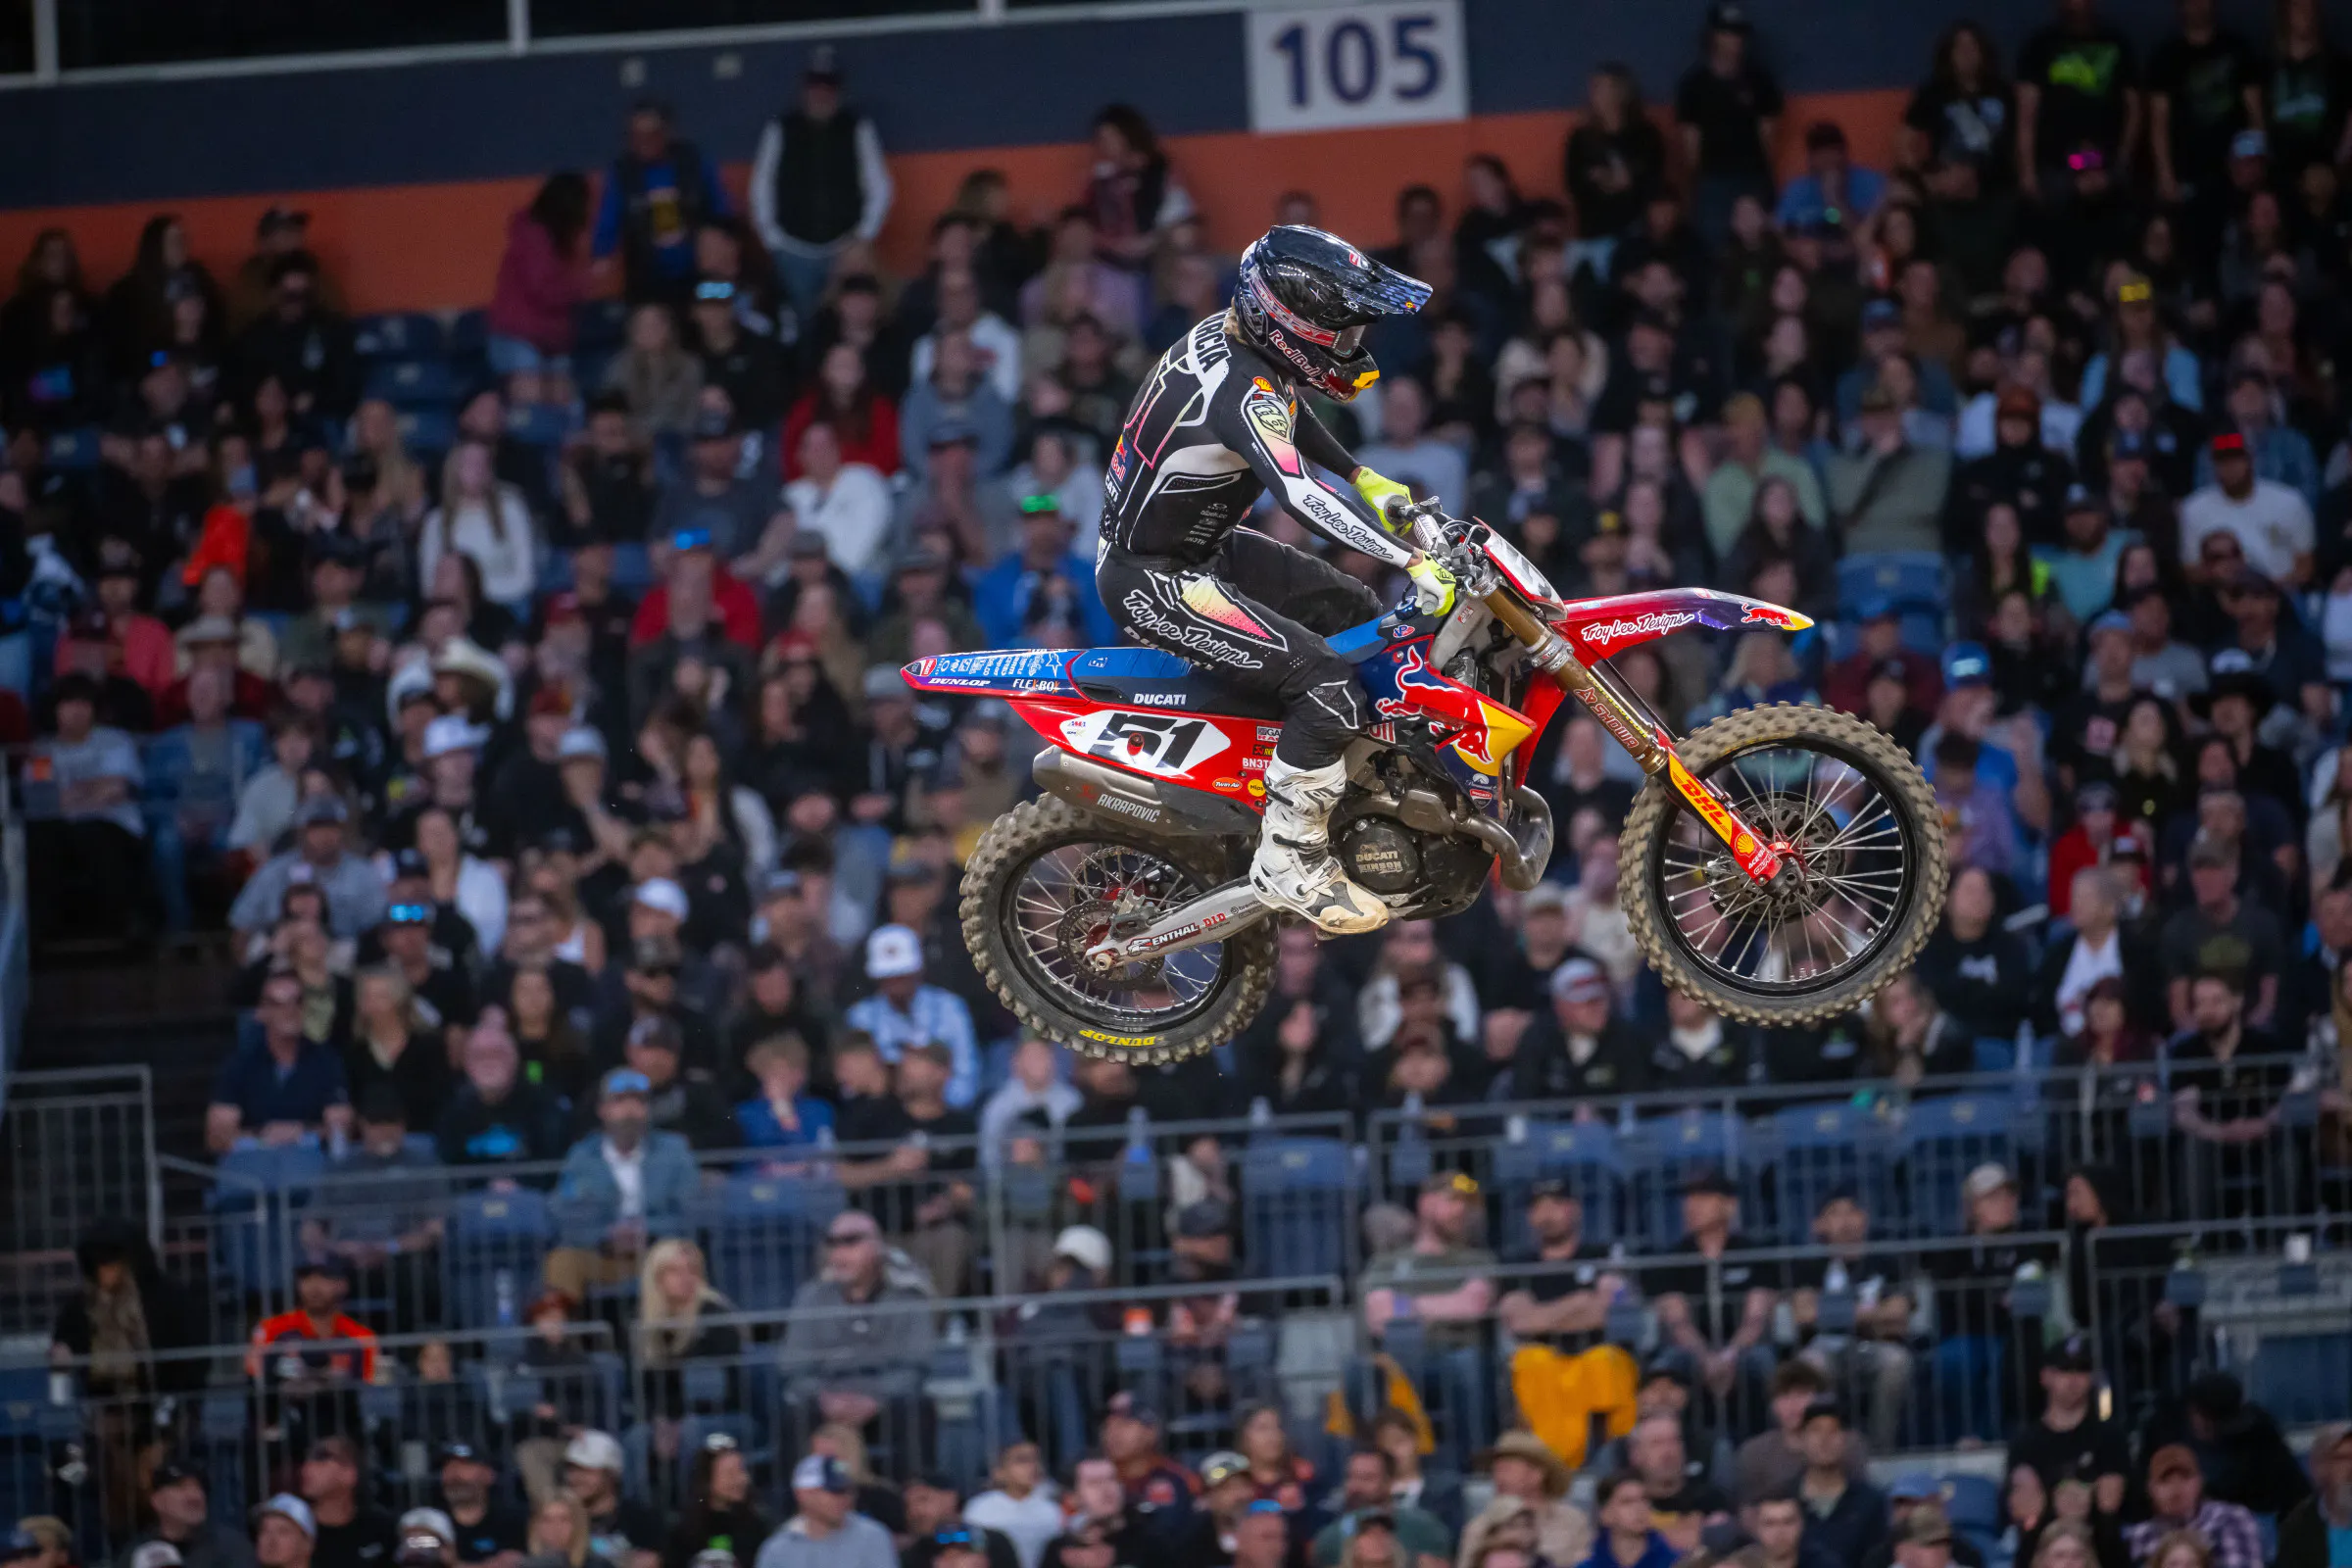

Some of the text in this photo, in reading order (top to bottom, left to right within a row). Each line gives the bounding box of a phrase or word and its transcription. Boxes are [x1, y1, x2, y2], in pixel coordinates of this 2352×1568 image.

[1272, 15, 1445, 109] 105
[1303, 493, 1329, 521] Troy
[1325, 511, 1349, 535] Lee
[1346, 524, 1395, 561] Designs
[1123, 588, 1157, 629] Troy
[1148, 612, 1182, 640] Lee
[1180, 625, 1263, 669] Designs
[1581, 612, 1696, 646] Troy Lee Designs
[928, 677, 991, 687] DUNLOP
[1133, 693, 1187, 706] DUCATI
[1087, 712, 1208, 770] 51
[1591, 702, 1641, 749] SHOWA
[1242, 757, 1272, 769] BN3T
[1680, 778, 1726, 826] DHL
[1355, 850, 1398, 862] DUCATI
[1079, 1029, 1156, 1047] DUNLOP
